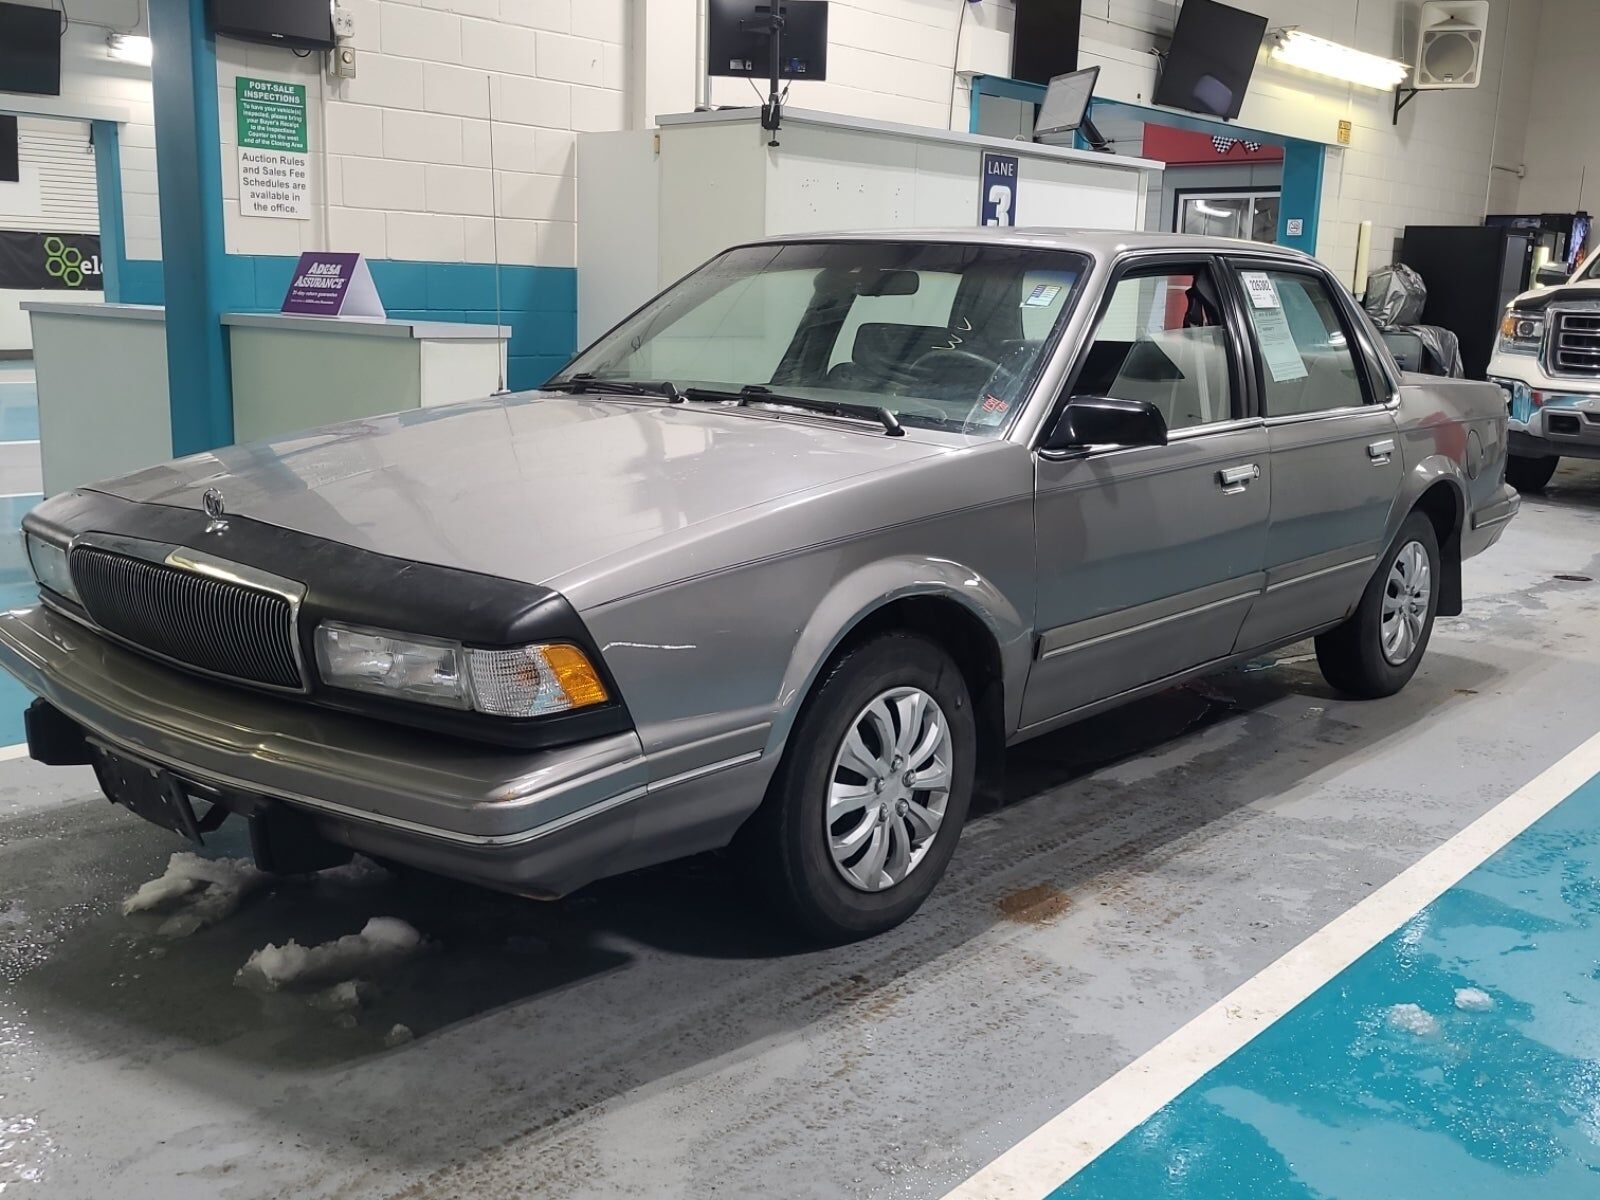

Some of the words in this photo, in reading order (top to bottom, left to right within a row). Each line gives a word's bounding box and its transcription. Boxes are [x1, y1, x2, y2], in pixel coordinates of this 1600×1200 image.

[250, 81, 295, 93] POST-SALE
[244, 90, 300, 103] INSPECTIONS
[271, 140, 290, 148] Closing
[242, 152, 277, 163] Auction
[280, 156, 305, 166] Rules
[243, 166, 259, 175] and
[262, 167, 286, 176] Sales
[290, 169, 305, 178] Fee
[988, 160, 1014, 177] LANE
[243, 177, 289, 188] Schedules
[250, 191, 289, 200] available
[292, 192, 300, 201] in
[254, 202, 268, 211] the
[270, 204, 298, 213] office.
[987, 185, 1012, 226] 3
[308, 262, 342, 275] ADESA
